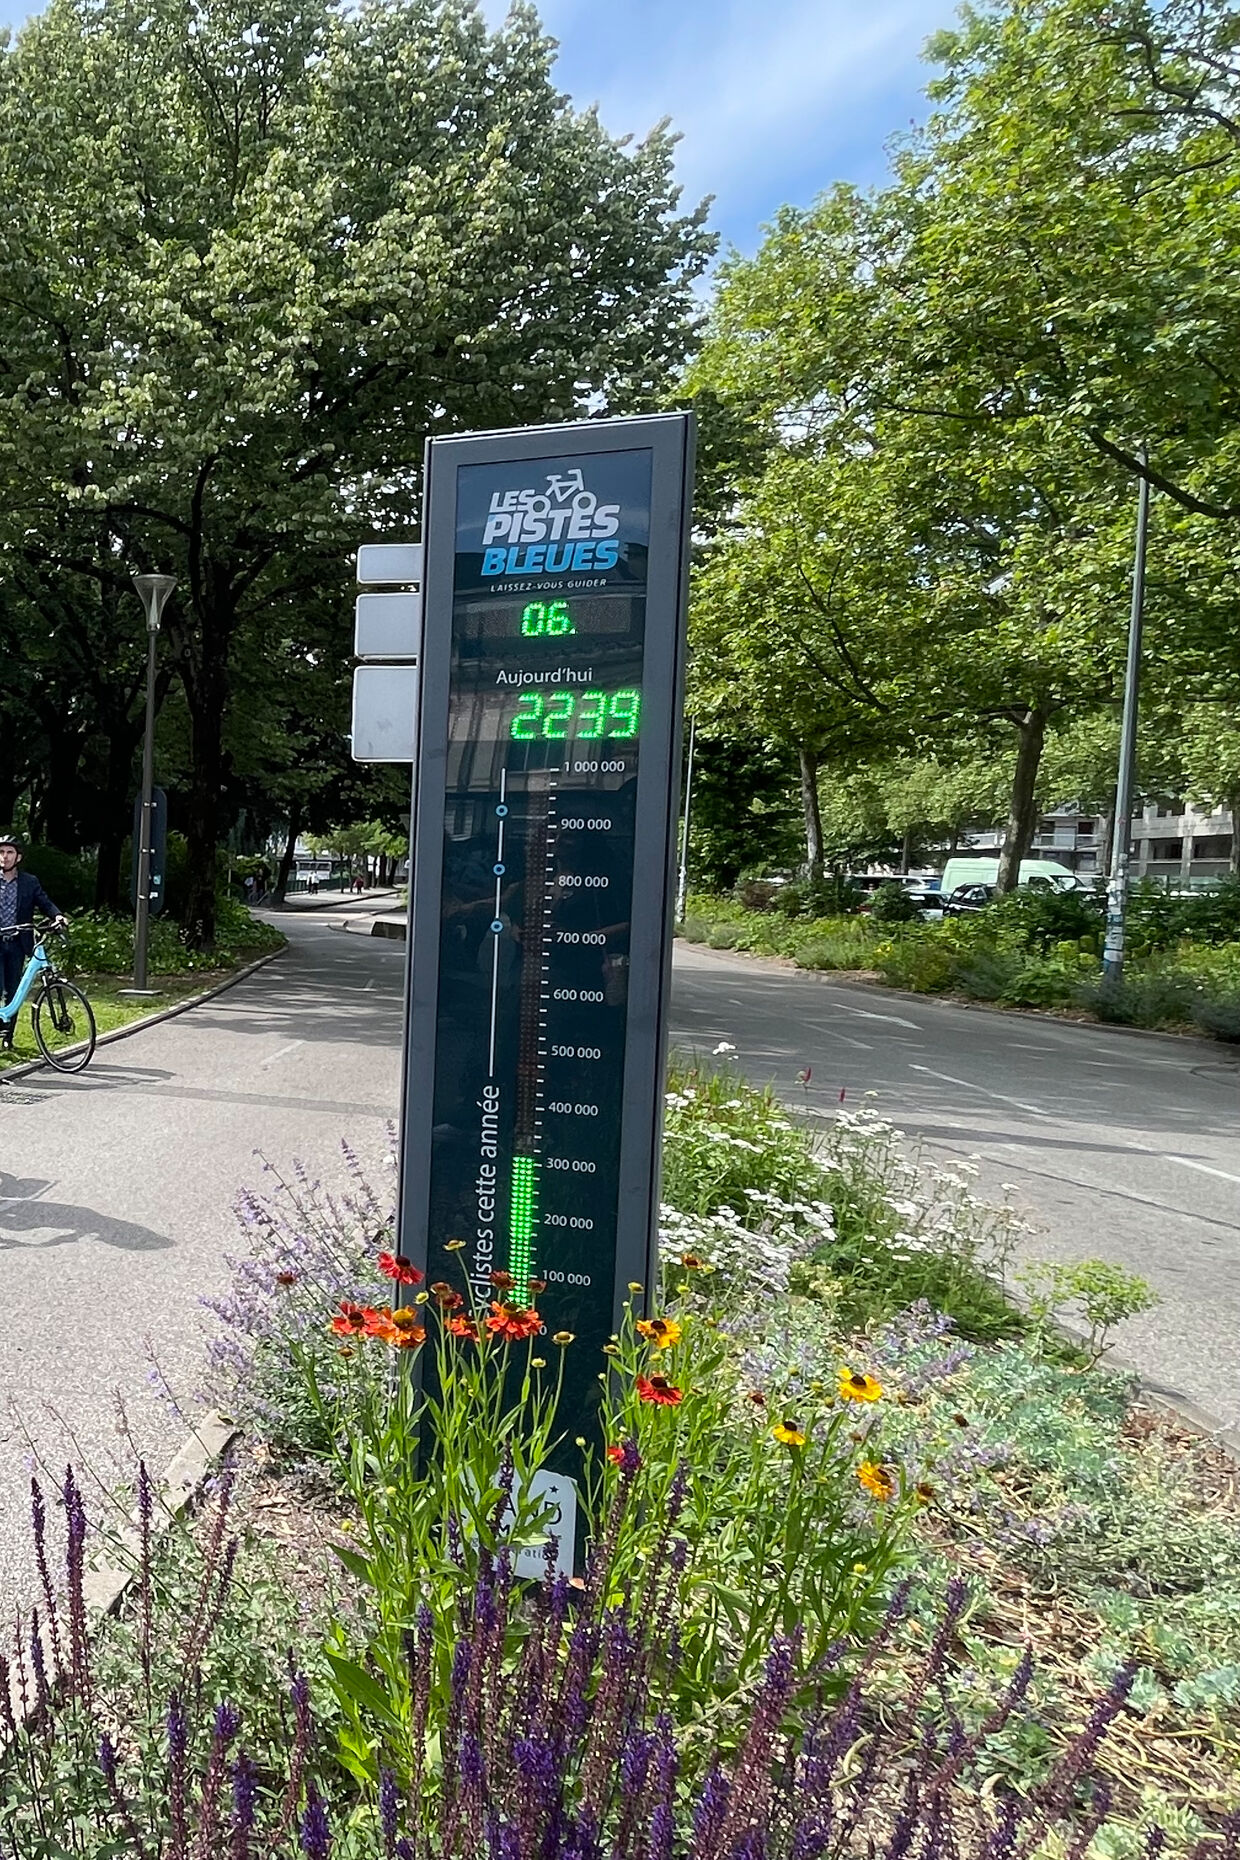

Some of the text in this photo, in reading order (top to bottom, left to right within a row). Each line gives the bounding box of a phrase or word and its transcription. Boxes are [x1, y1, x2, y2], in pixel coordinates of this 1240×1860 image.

[489, 489, 535, 513] LES
[482, 504, 620, 545] PISTES
[481, 539, 619, 576] BLEUES
[490, 578, 607, 592] LAISSEZ-VOUS GUIDER
[495, 667, 593, 687] Aujourd'hui
[510, 689, 641, 739] 2239
[564, 760, 625, 773] 1 000 000
[561, 818, 612, 830] 900 000
[558, 875, 609, 888] 800 000
[556, 931, 606, 945] 700 000
[553, 988, 604, 1003] 600 000
[551, 1045, 601, 1060] 500 000
[548, 1101, 599, 1116] 400 000
[476, 1085, 500, 1159] année
[546, 1157, 596, 1173] 300 000
[475, 1163, 497, 1223] cette
[544, 1213, 594, 1230] 200 000
[541, 1269, 591, 1286] 100 000
